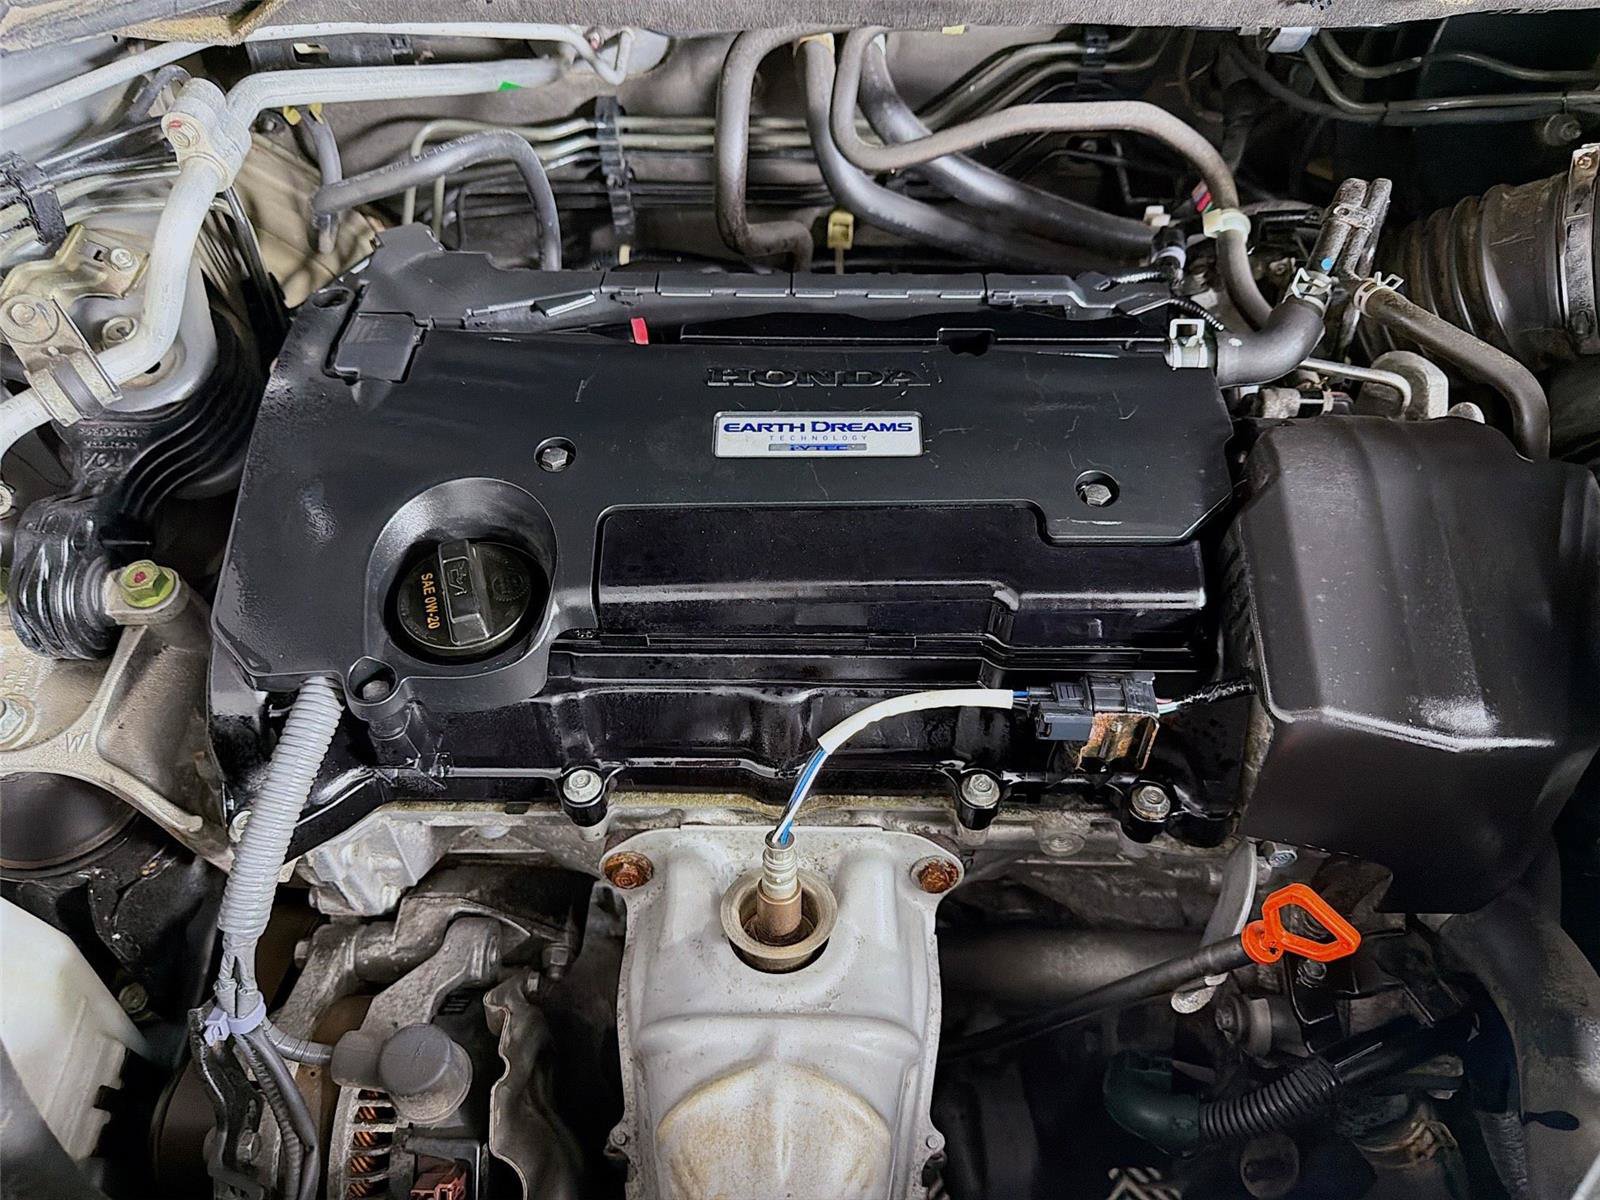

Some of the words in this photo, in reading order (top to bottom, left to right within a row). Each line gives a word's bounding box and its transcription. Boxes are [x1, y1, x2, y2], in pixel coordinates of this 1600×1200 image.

[707, 368, 931, 387] HONDA
[723, 422, 805, 433] EARTH
[811, 421, 914, 433] DREAMS
[421, 572, 435, 595] SAE
